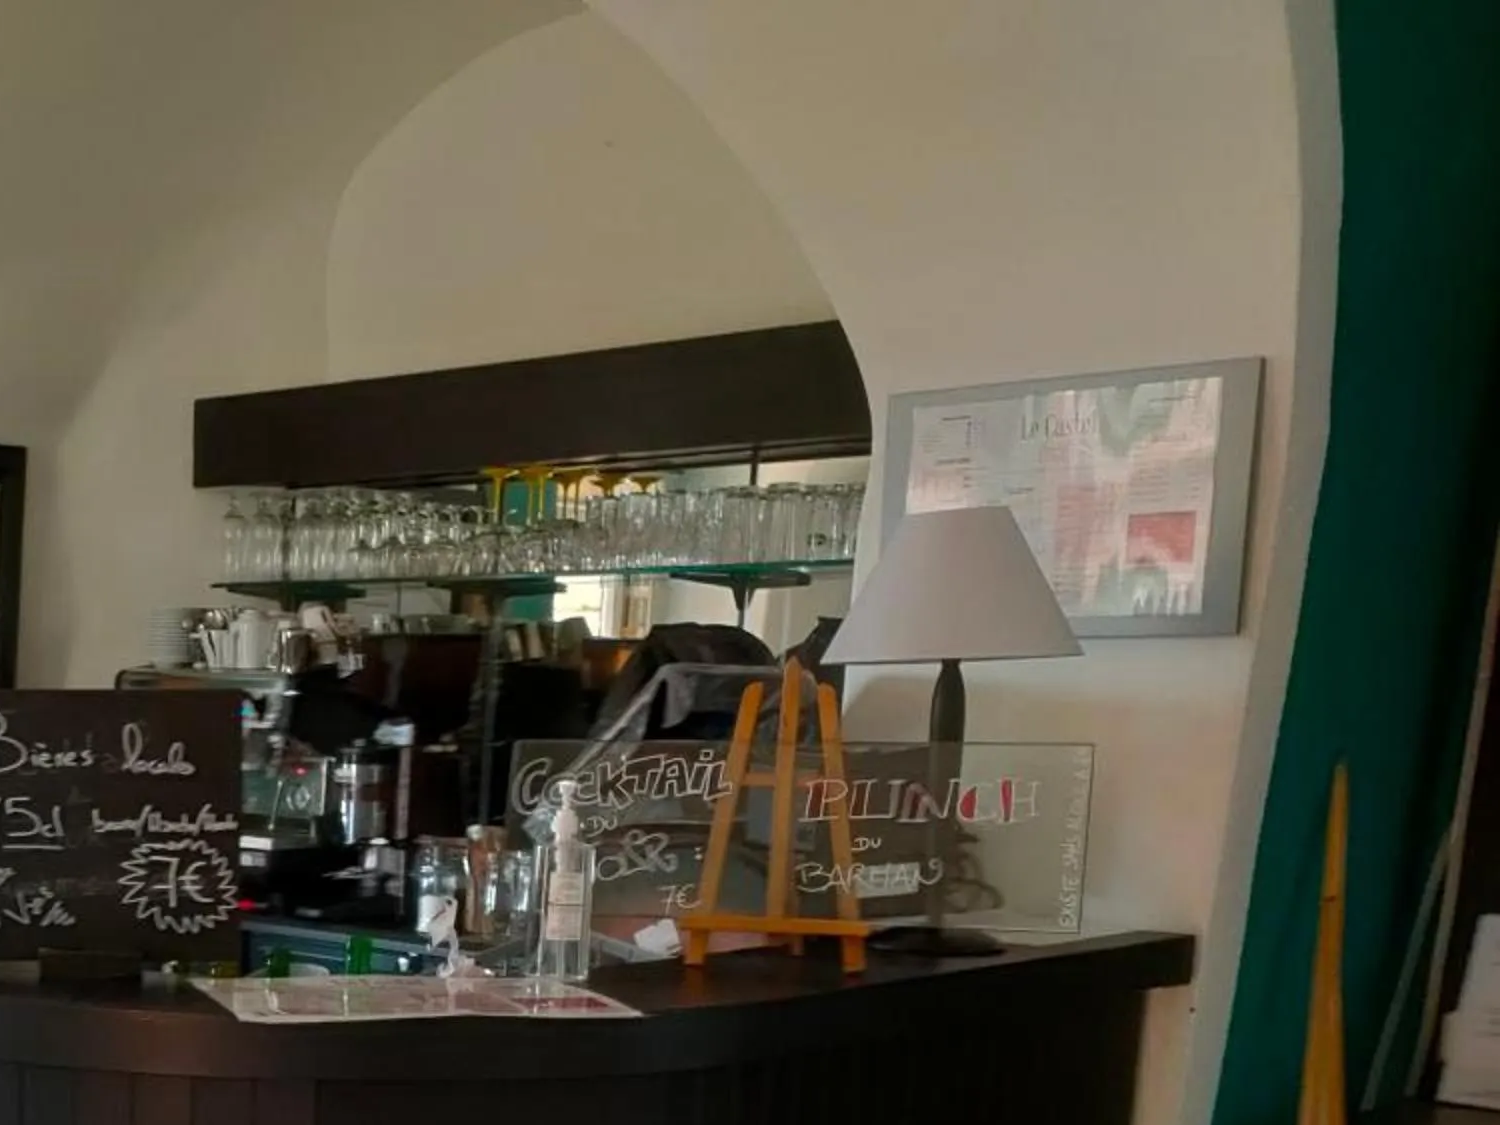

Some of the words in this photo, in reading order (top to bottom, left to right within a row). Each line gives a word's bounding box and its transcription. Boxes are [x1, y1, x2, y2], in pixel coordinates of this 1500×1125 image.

[797, 778, 1042, 823] PUNCH
[851, 837, 882, 851] DU
[149, 856, 214, 908] 7€
[658, 883, 701, 916] 7€
